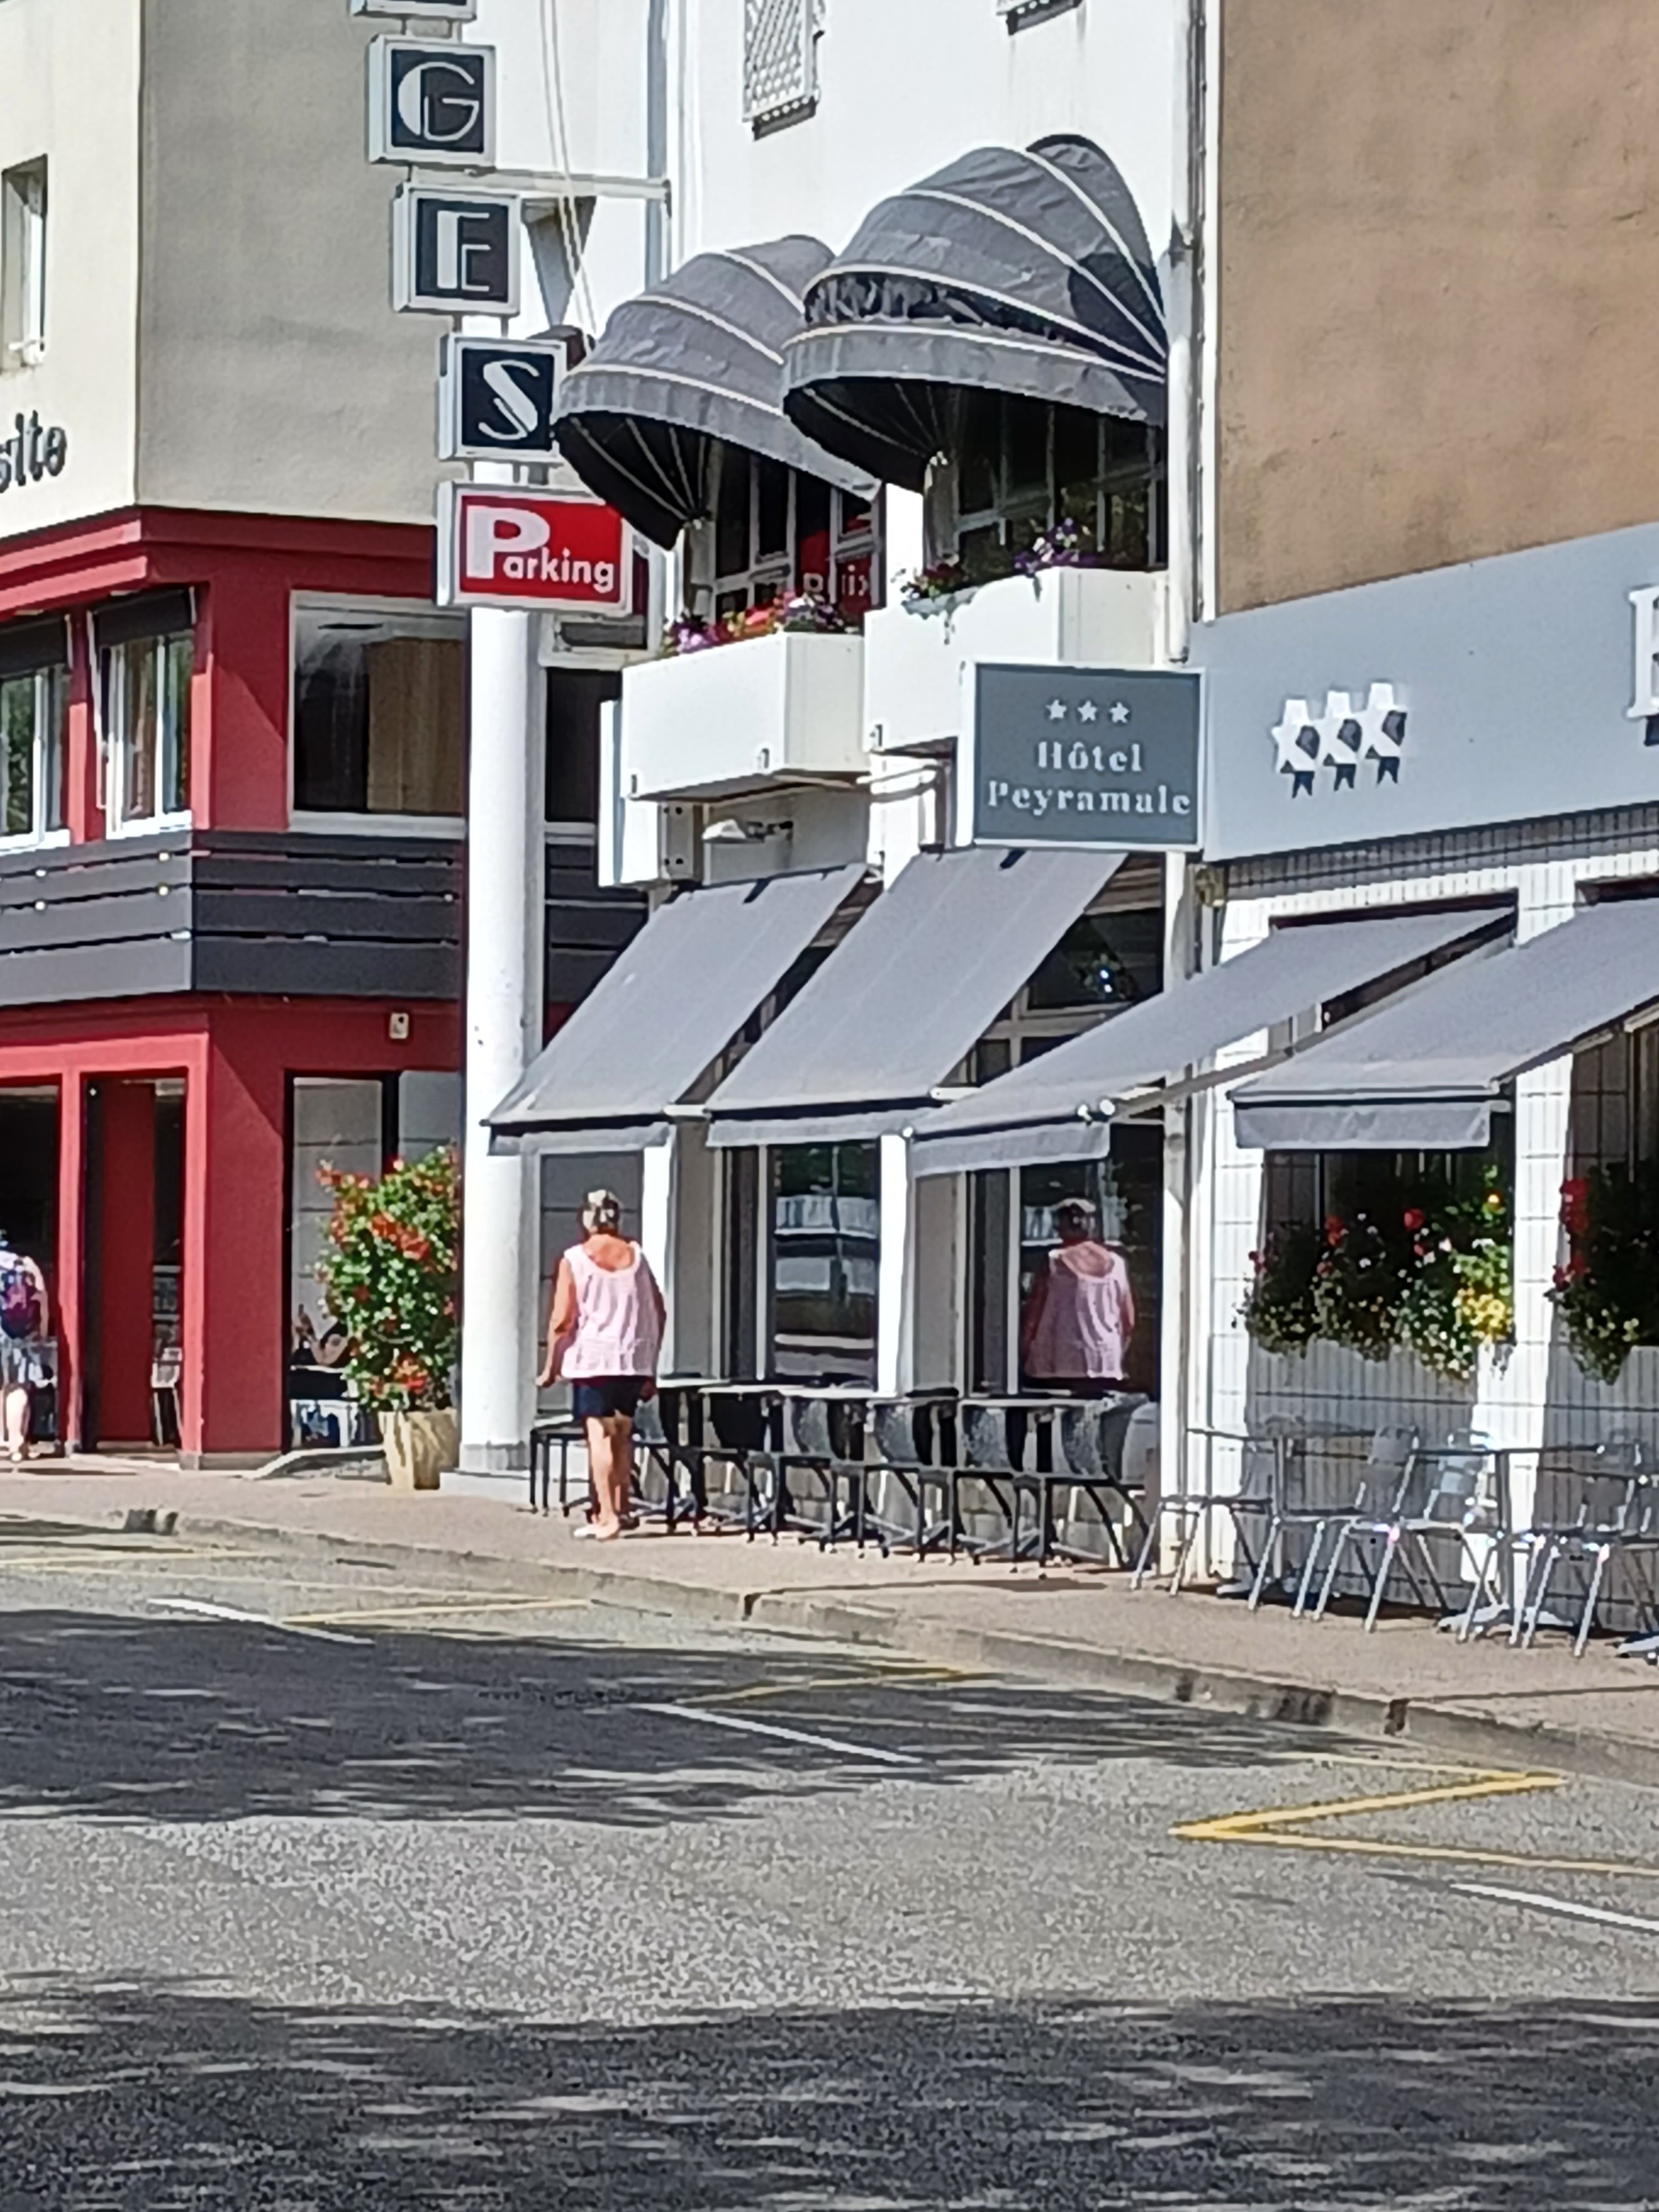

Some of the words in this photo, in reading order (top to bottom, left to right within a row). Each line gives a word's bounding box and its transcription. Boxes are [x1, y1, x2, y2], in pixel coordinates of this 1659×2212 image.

[466, 505, 614, 593] Parking
[1037, 741, 1142, 773] Hôtel
[988, 780, 1191, 816] Peyramale
